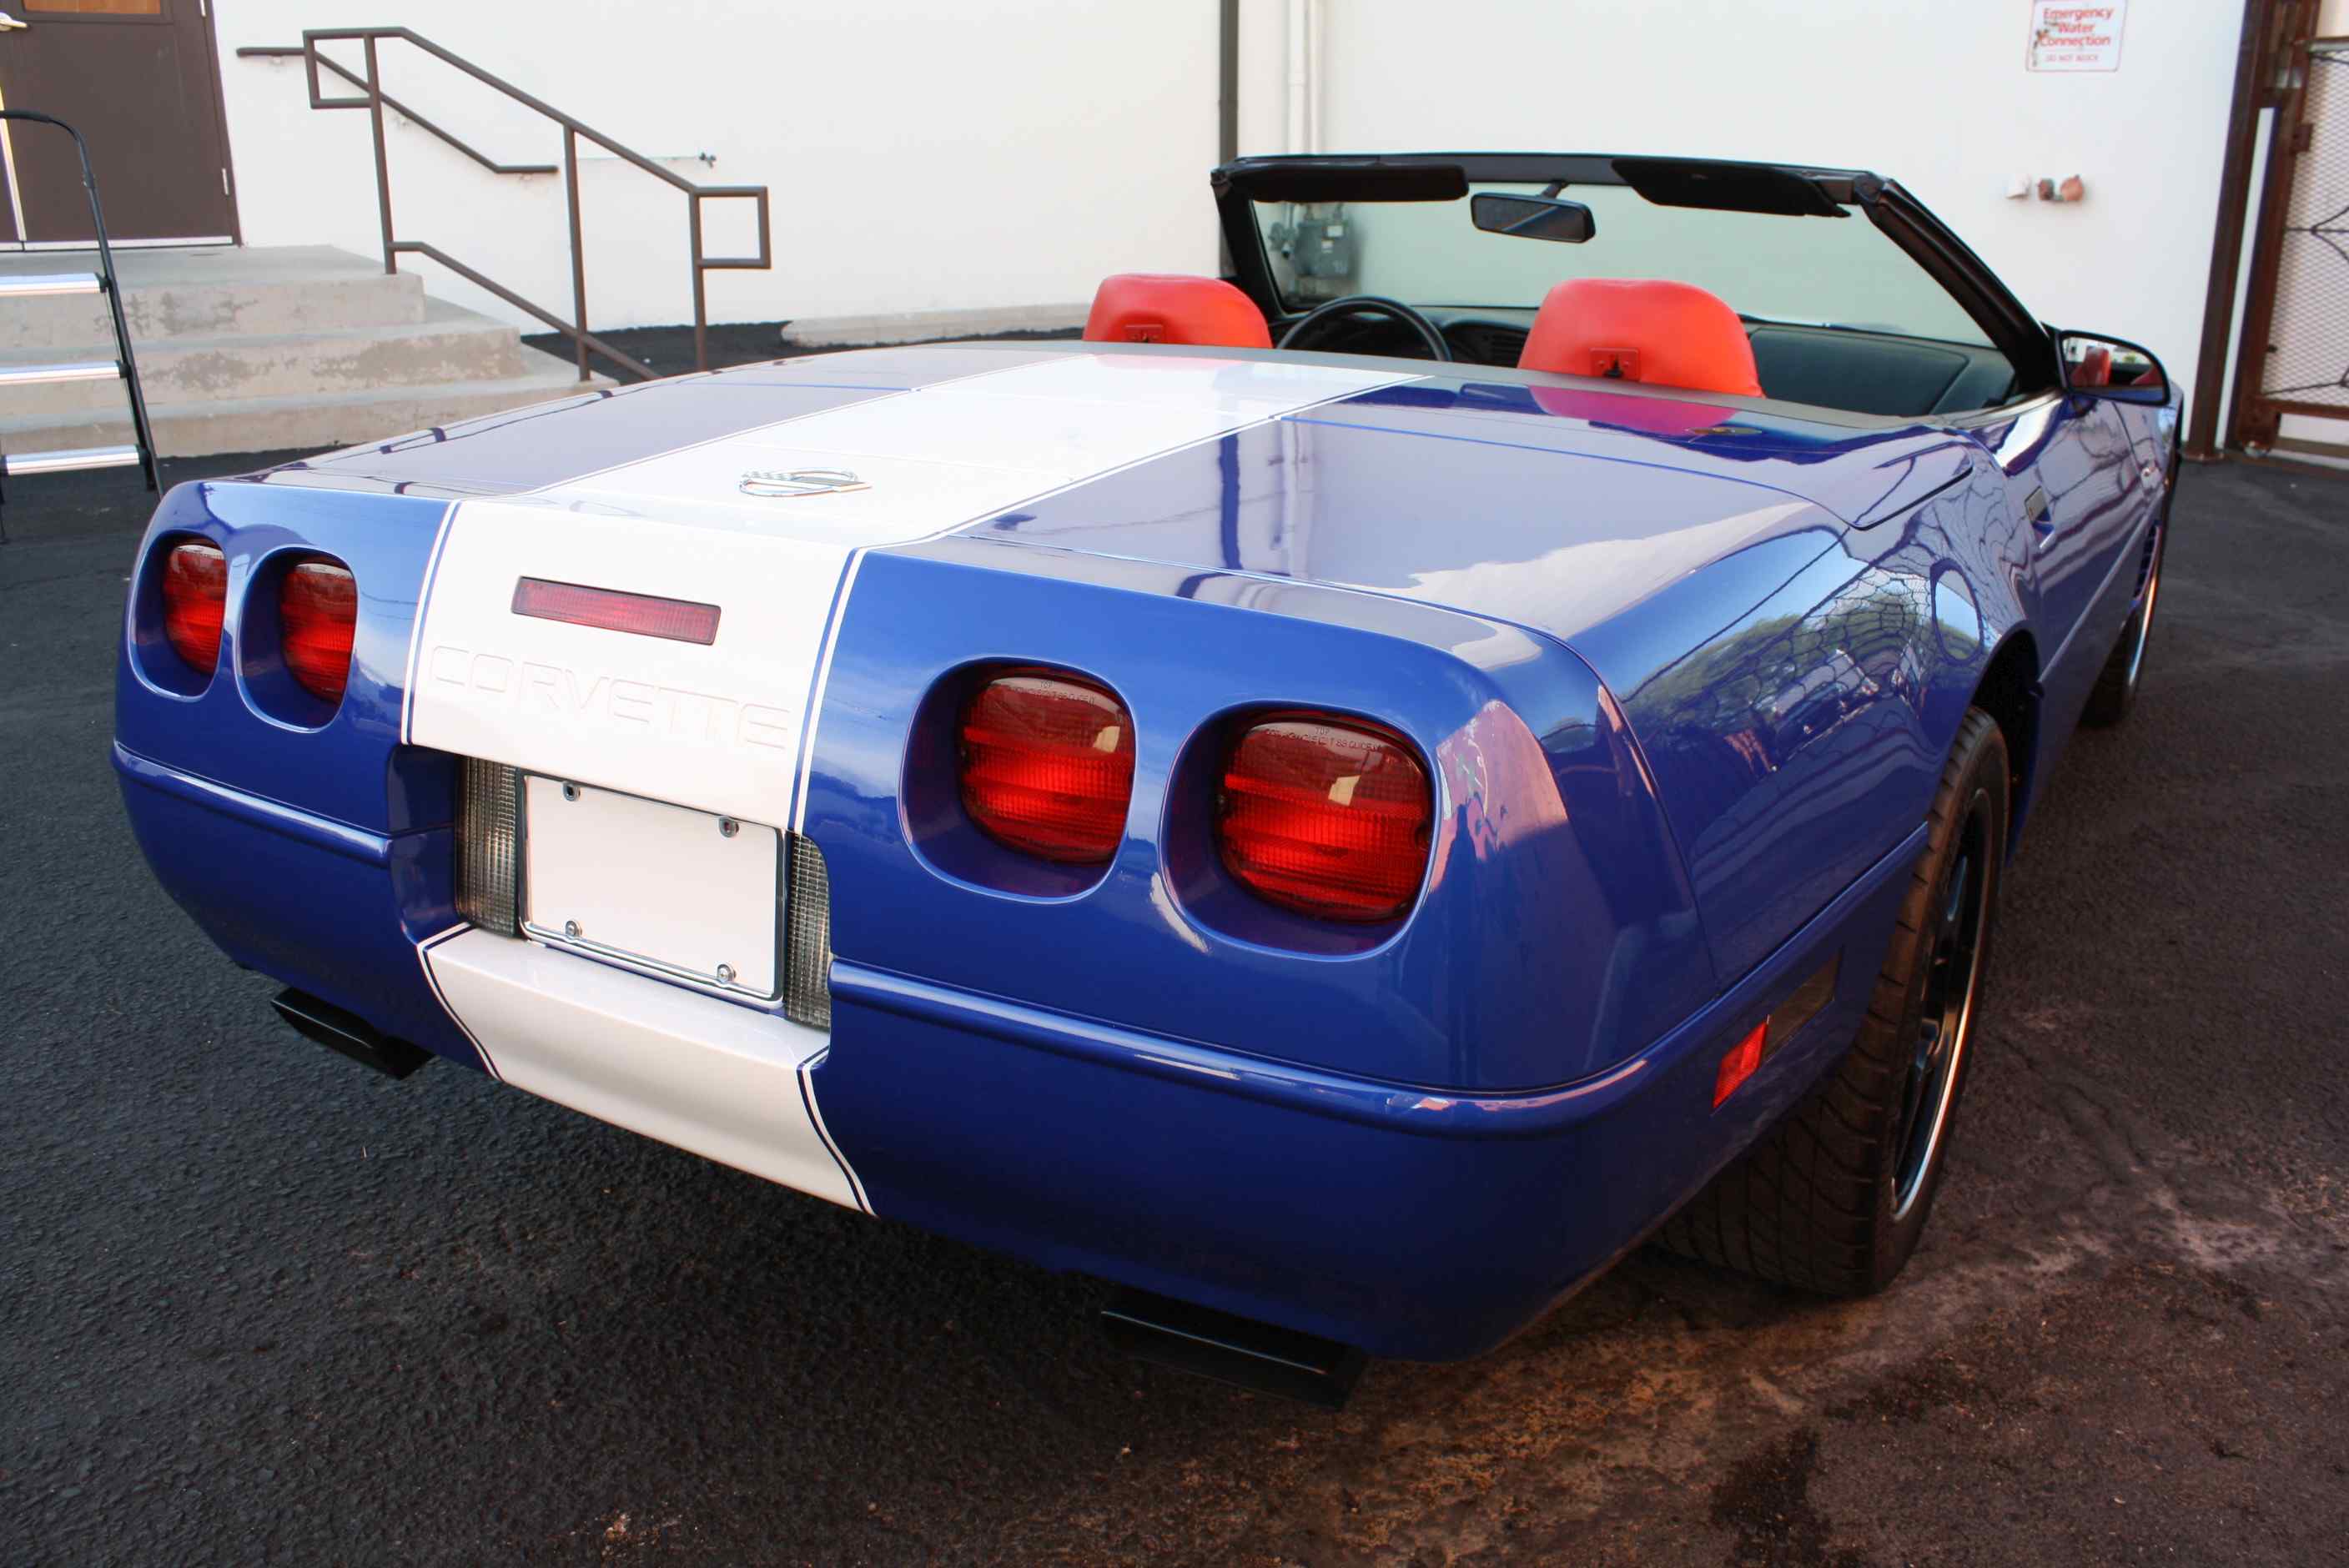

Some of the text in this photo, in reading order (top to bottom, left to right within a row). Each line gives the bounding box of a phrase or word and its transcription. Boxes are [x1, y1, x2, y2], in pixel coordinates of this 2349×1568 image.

[2043, 8, 2114, 20] Emergency
[2057, 23, 2095, 33] Water
[2040, 36, 2111, 47] Connection
[429, 645, 792, 750] CORVETTE
